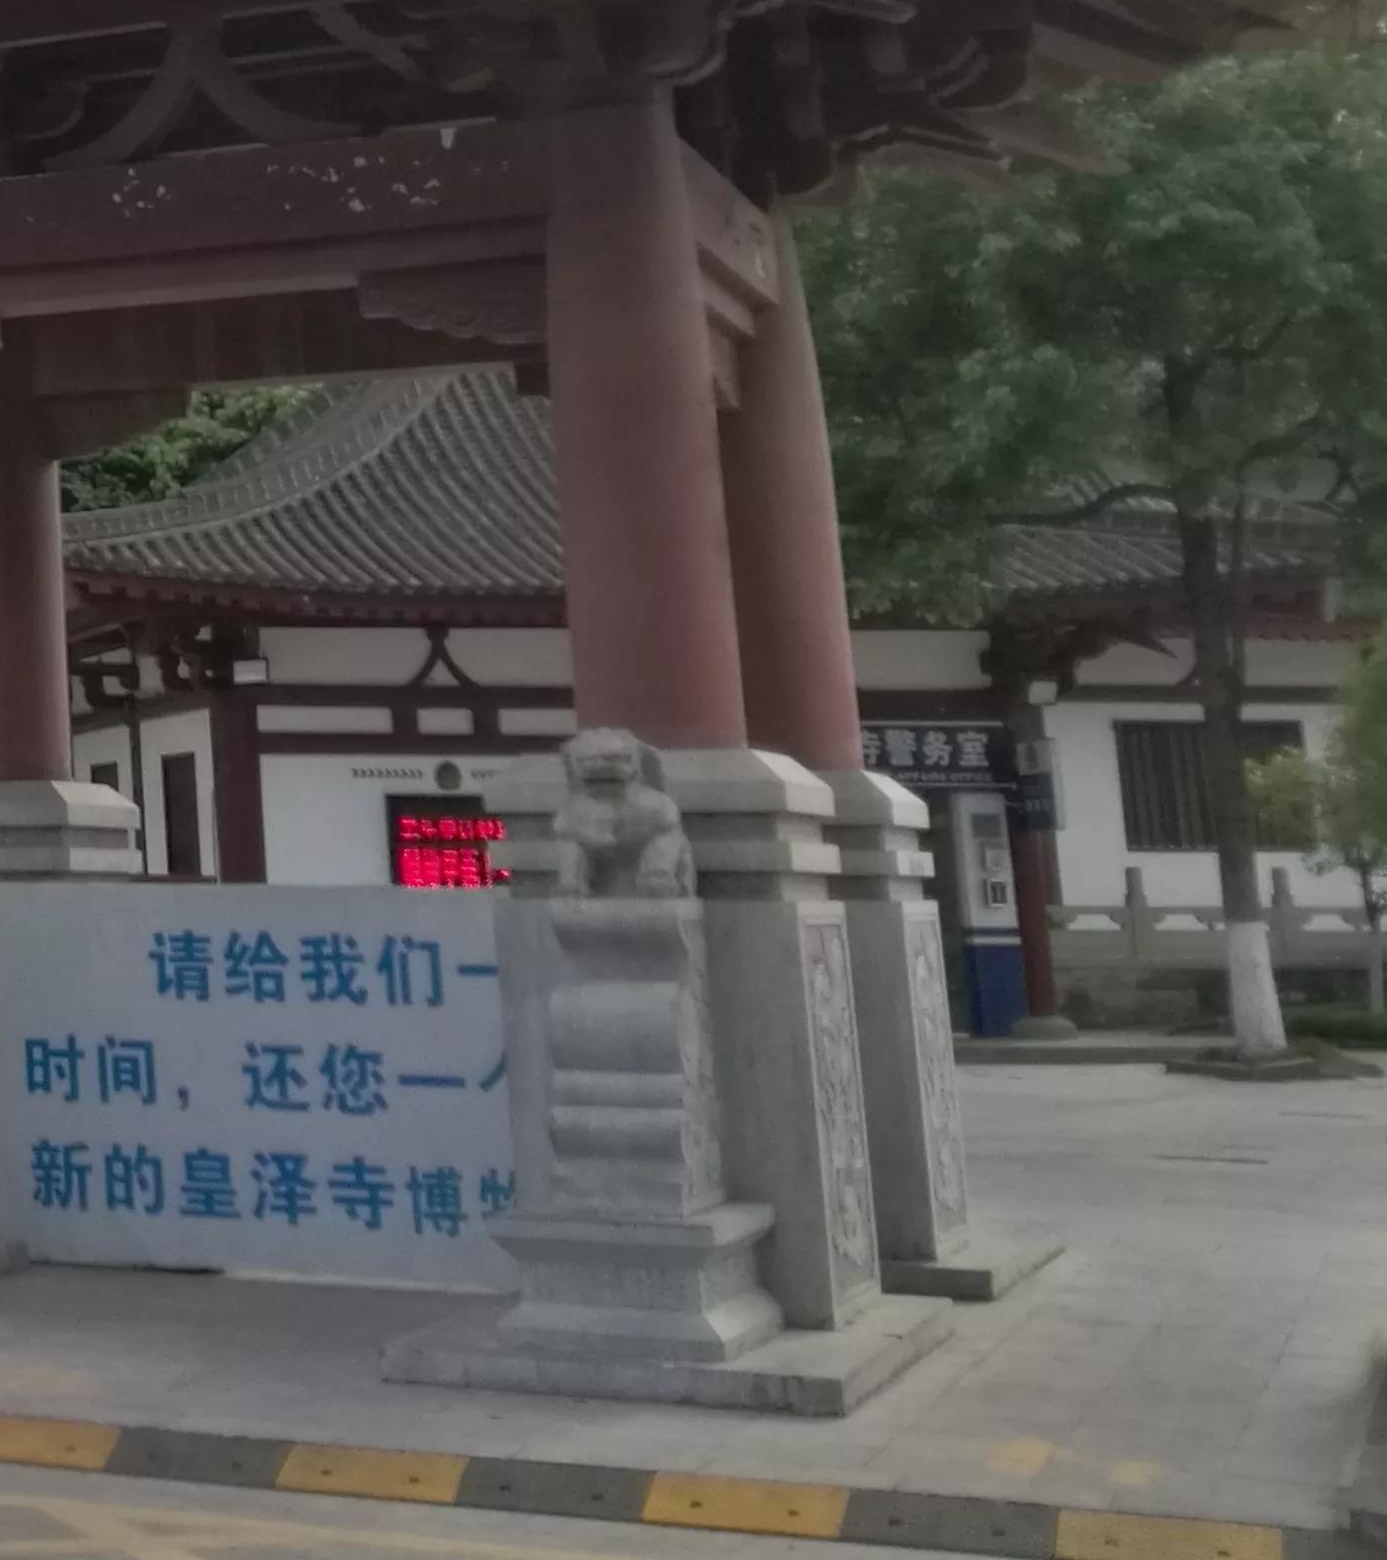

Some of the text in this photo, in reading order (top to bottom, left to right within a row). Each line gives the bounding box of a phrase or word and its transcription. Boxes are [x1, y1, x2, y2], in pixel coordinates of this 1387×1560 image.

[148, 929, 499, 1007] 请给我们一
[23, 1032, 507, 1117] 时间，还您一
